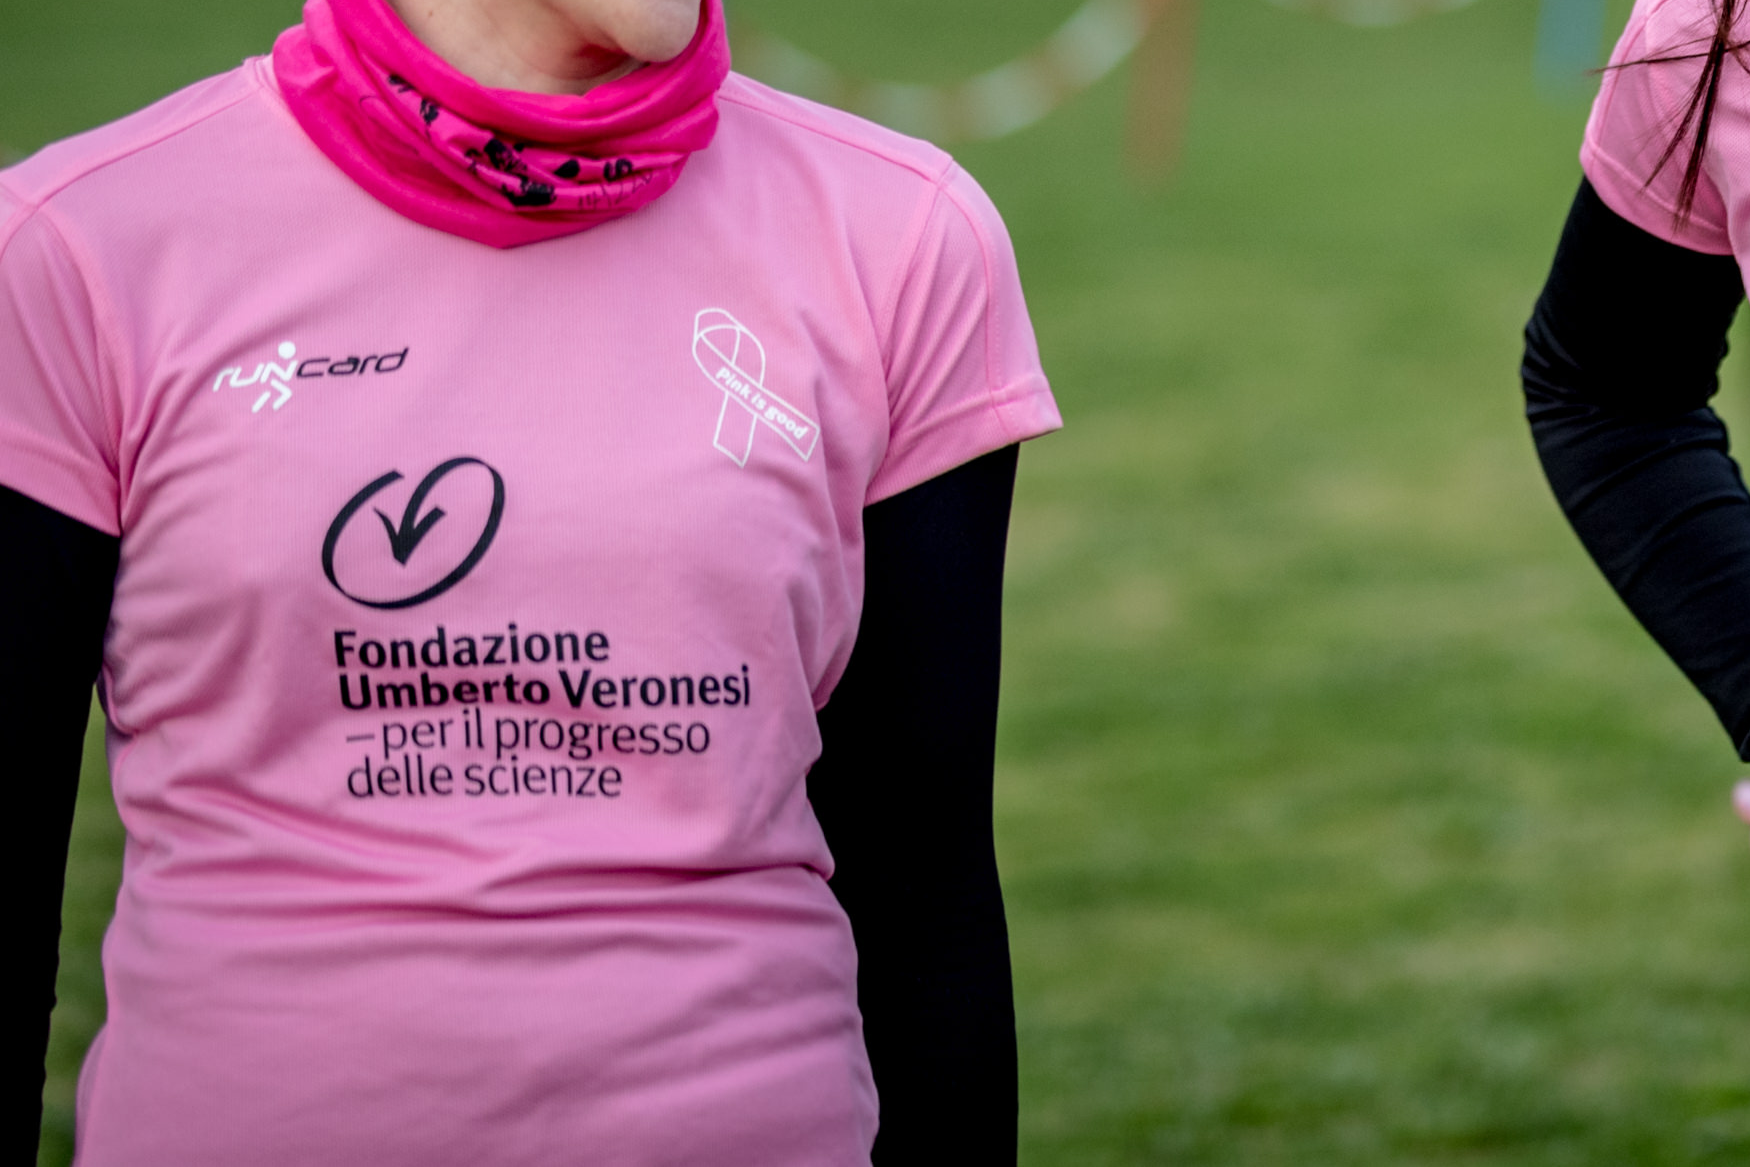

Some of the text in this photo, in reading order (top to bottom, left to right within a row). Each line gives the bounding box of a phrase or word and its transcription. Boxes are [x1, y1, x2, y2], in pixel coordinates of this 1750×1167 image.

[715, 367, 809, 440] Pink is good
[334, 622, 609, 669] Fondazione
[339, 663, 750, 710] Umberto Veronesi
[463, 706, 485, 750] il
[495, 717, 710, 761] progresso
[347, 753, 622, 798] delle scienze
